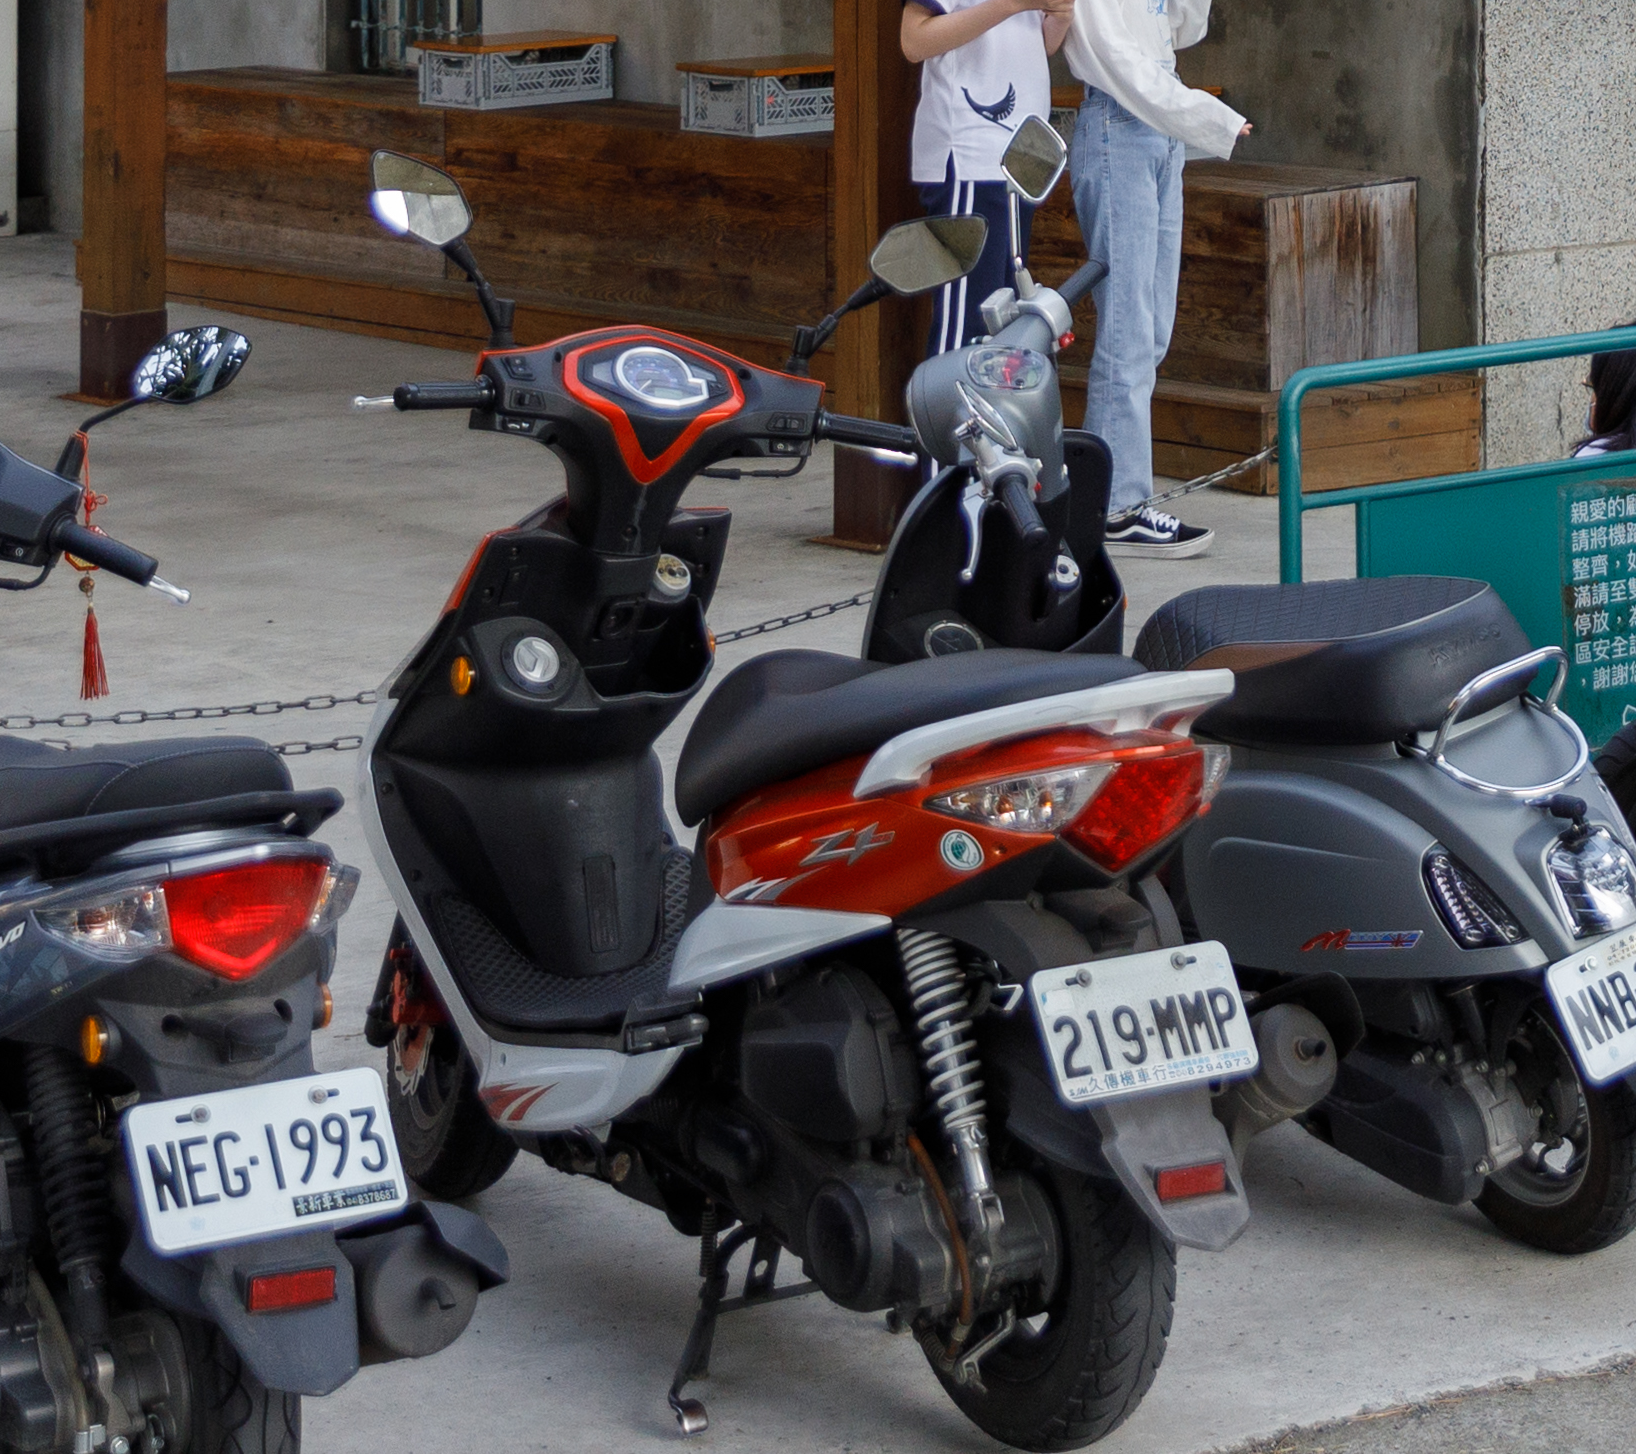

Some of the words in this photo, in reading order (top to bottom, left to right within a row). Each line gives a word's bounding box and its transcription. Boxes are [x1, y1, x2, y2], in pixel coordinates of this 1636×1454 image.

[1053, 986, 1237, 1079] 219-MMP
[1089, 1065, 1166, 1092] 久傳機車行
[145, 1106, 389, 1212] NEG-1993
